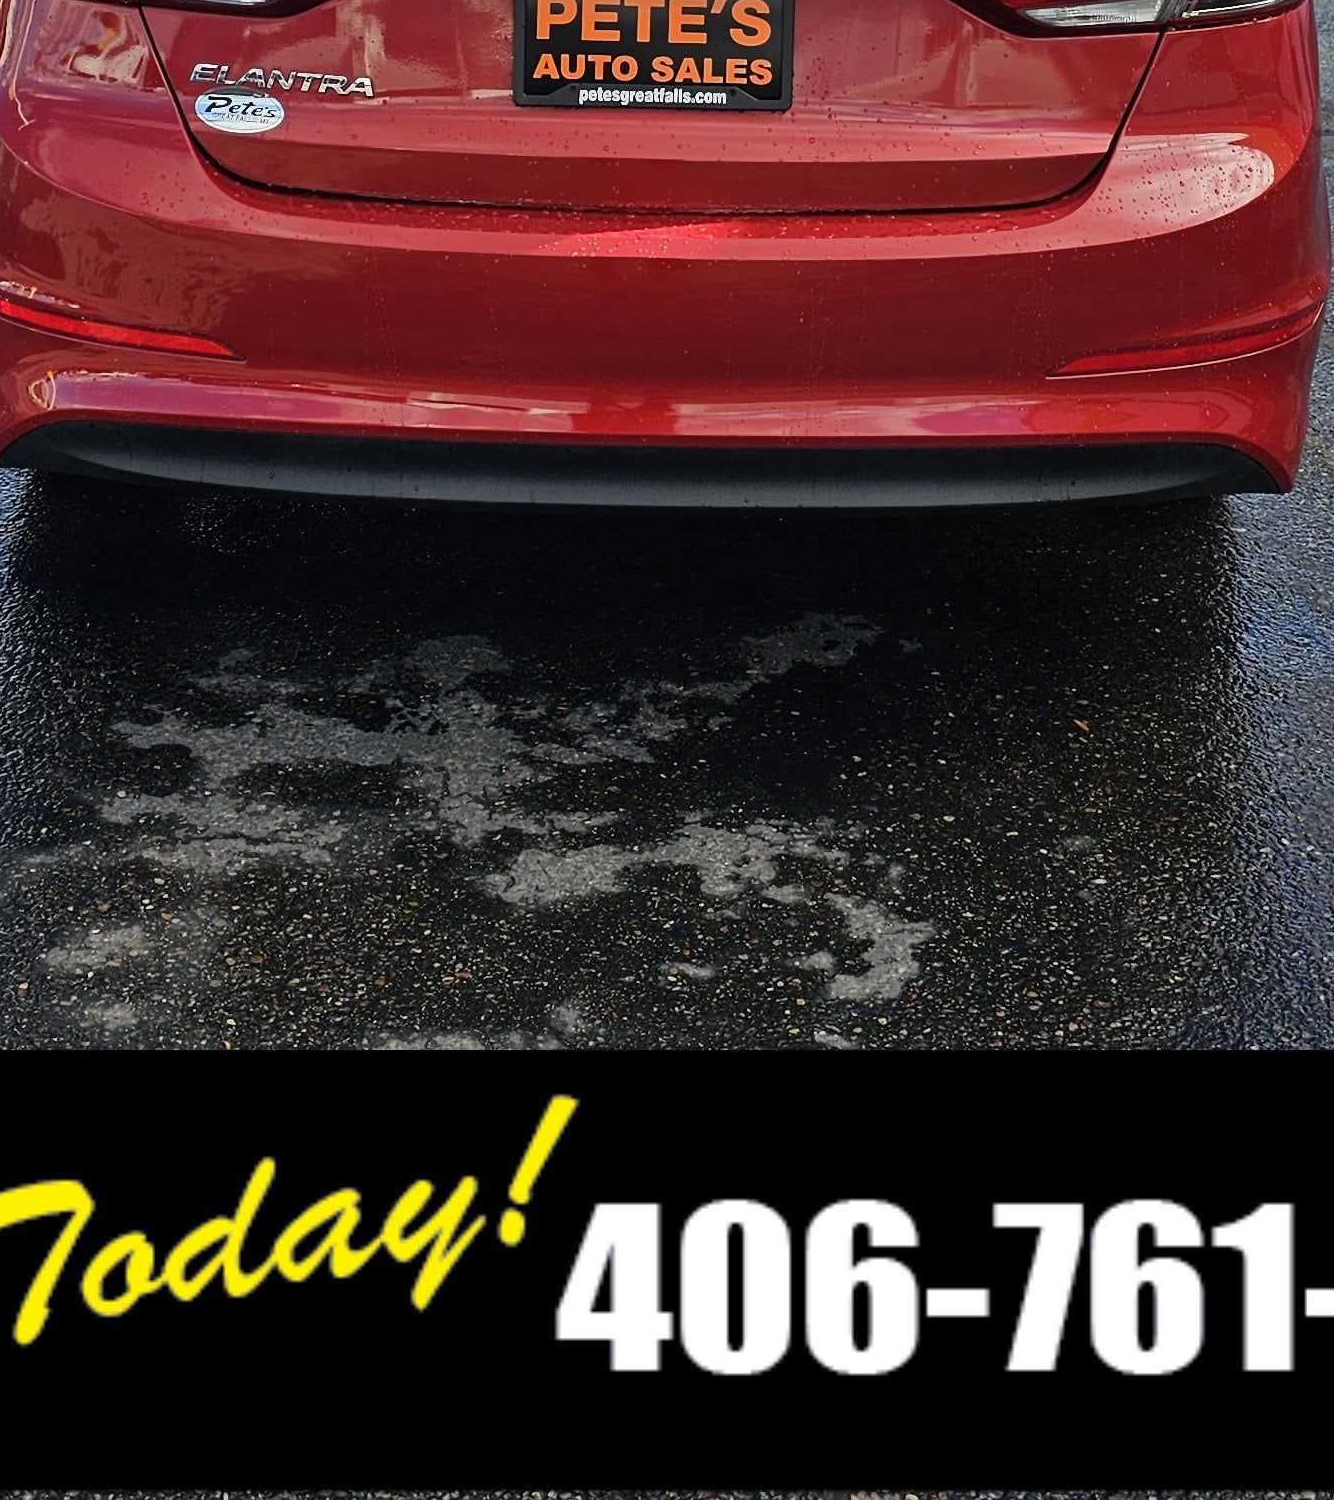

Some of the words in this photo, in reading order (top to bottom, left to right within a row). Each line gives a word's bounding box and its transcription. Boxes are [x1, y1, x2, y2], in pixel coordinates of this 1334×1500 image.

[190, 63, 374, 97] ELANTRA
[533, 54, 639, 80] AUTO
[651, 57, 773, 86] SALES
[205, 96, 278, 118] Pete's
[579, 87, 727, 106] petesgreatfalls.com
